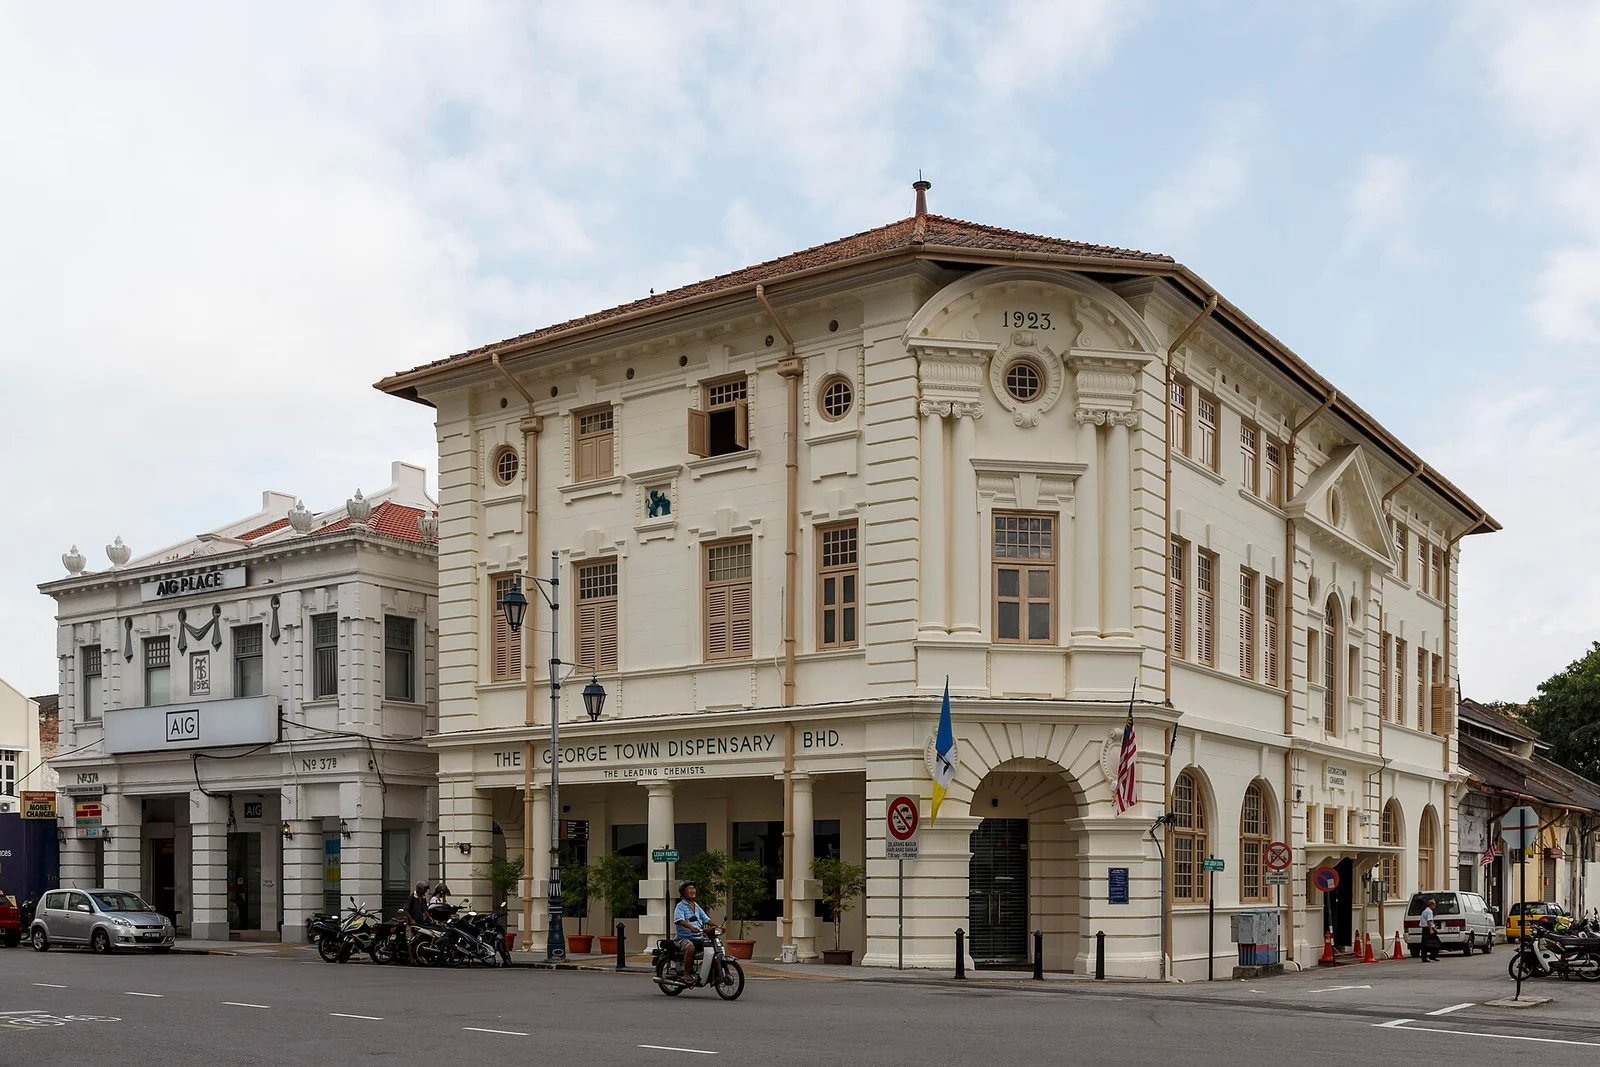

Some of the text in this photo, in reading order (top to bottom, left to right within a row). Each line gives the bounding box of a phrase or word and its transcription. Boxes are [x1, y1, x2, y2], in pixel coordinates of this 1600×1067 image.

[1002, 310, 1056, 330] 1923.
[156, 572, 224, 596] AIG PLACE
[171, 717, 195, 735] AIG
[494, 729, 844, 767] THE GEORGE TOWN DISPENSARY BHD.
[604, 766, 706, 778] THE LEADING CHEMISTS.
[26, 810, 56, 818] CHANGER
[246, 805, 262, 816] AIG
